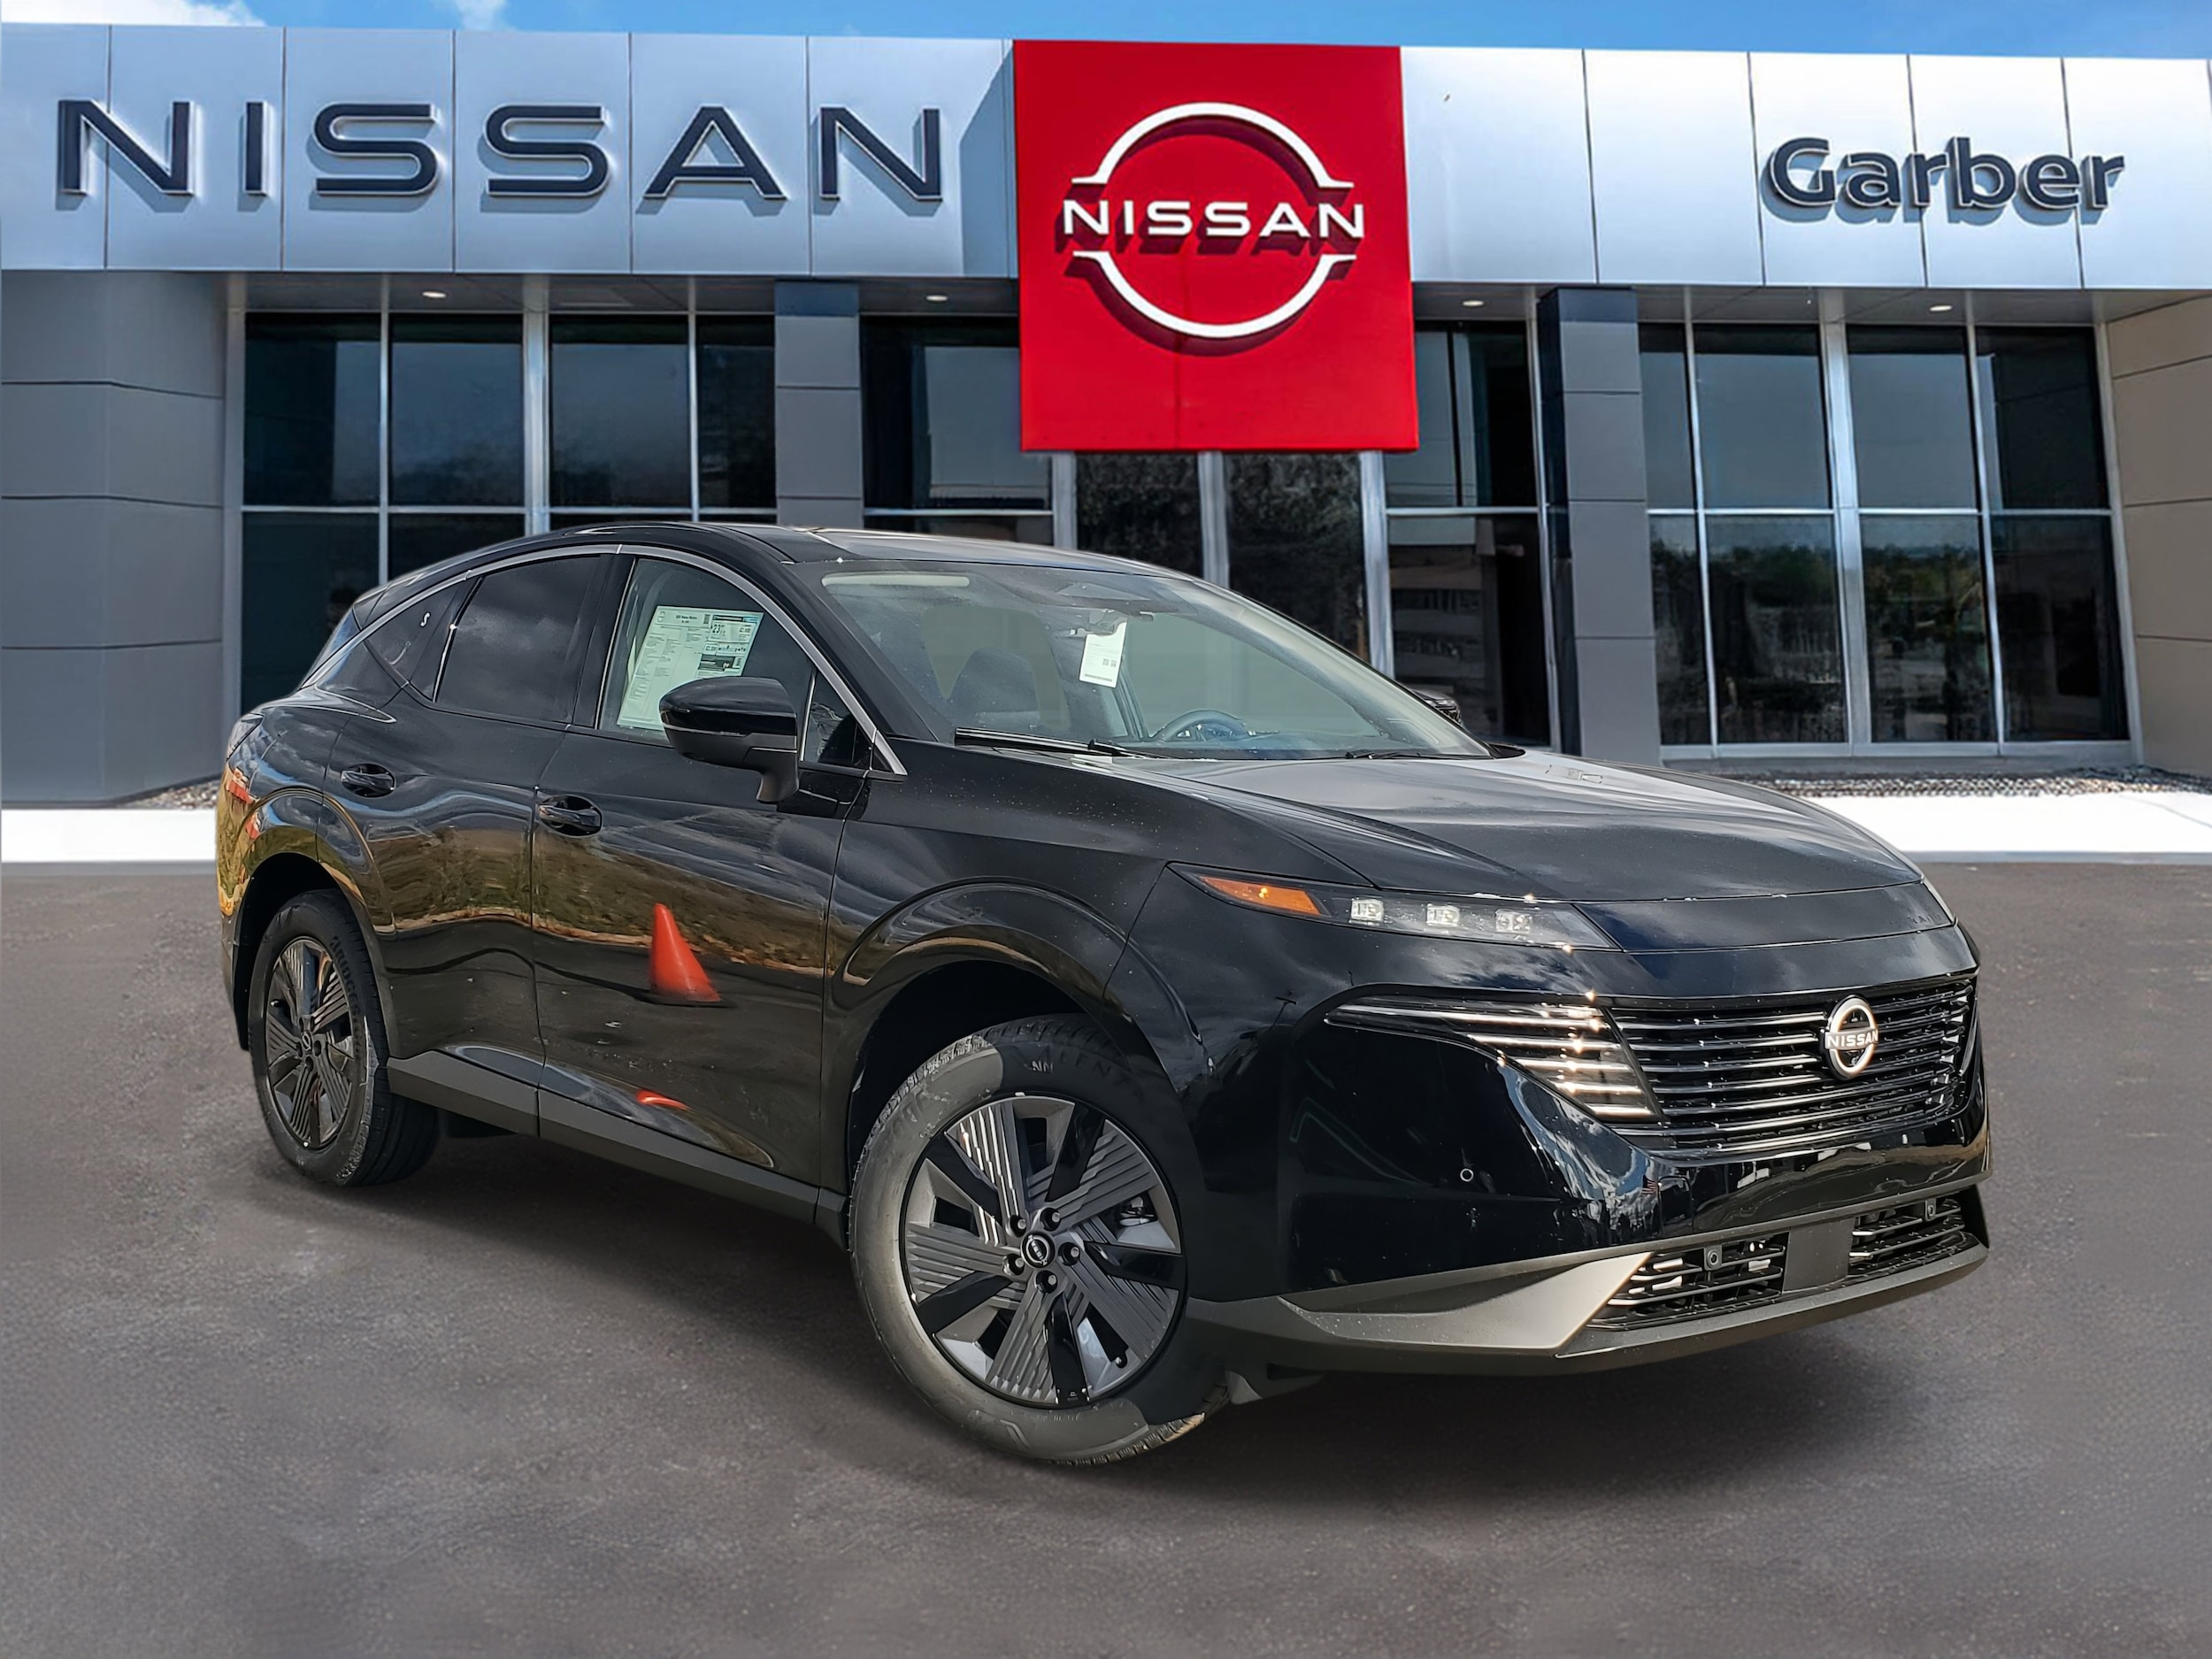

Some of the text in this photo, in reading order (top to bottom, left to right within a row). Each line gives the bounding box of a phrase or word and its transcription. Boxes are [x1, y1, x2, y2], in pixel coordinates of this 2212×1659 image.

[58, 99, 944, 201] NISSAN
[1771, 135, 2125, 208] Garber
[1063, 199, 1364, 238] NISSAN
[1827, 1028, 1879, 1048] NISSAN
